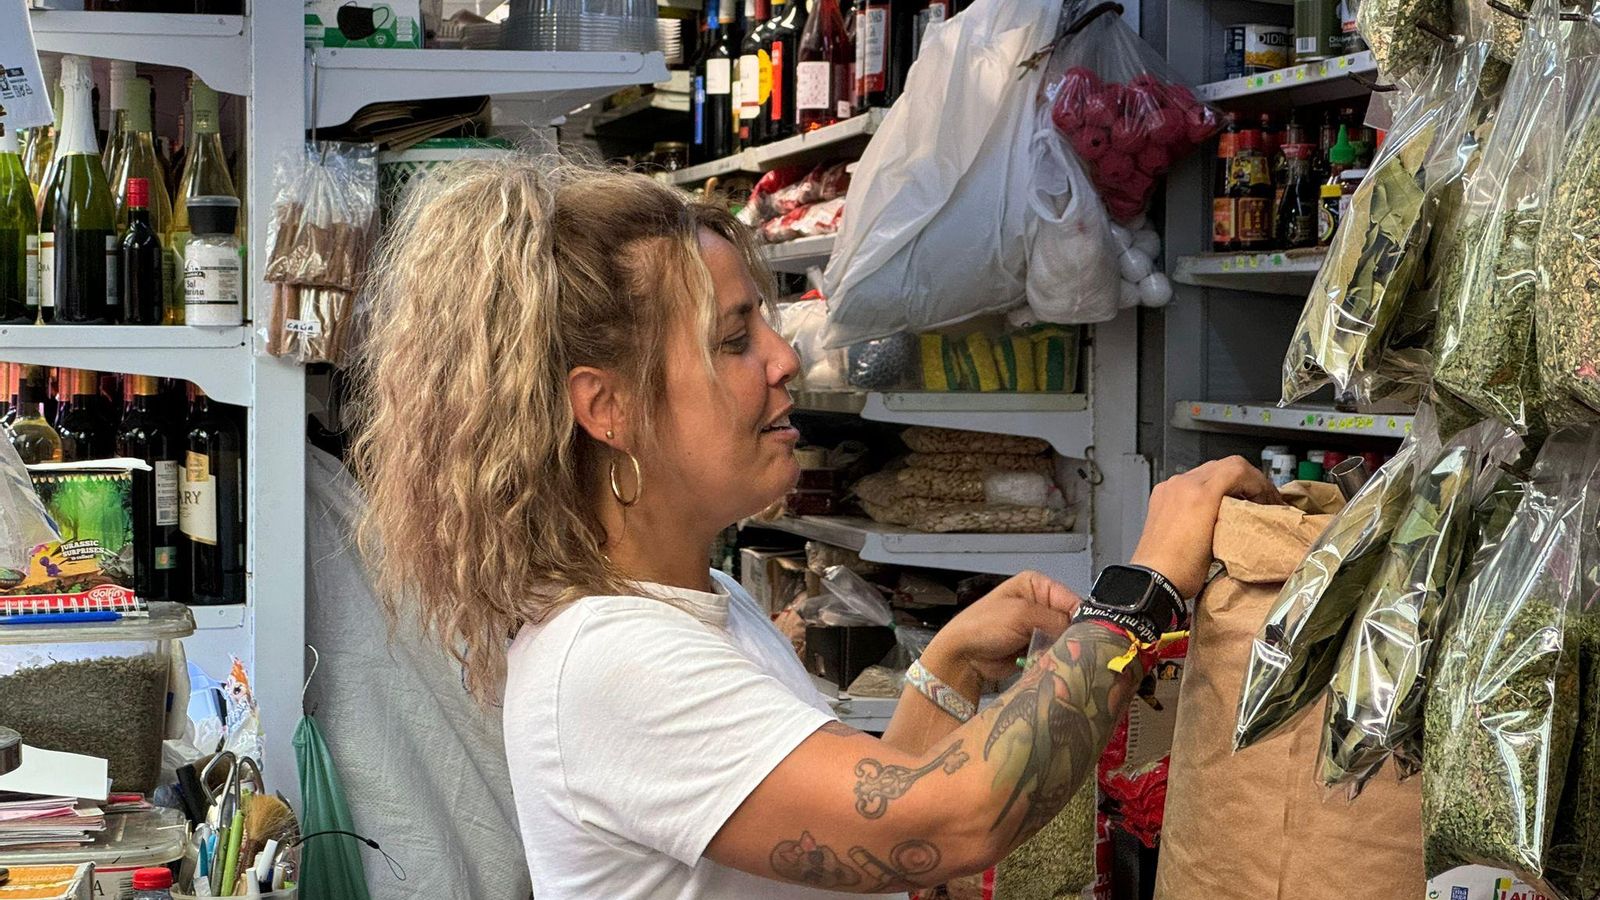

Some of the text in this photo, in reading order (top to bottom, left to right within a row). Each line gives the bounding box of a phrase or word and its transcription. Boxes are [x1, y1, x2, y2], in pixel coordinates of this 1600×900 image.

[61, 540, 99, 552] JURASSIC
[62, 547, 105, 557] SURPRISES
[92, 587, 121, 598] dolfin
